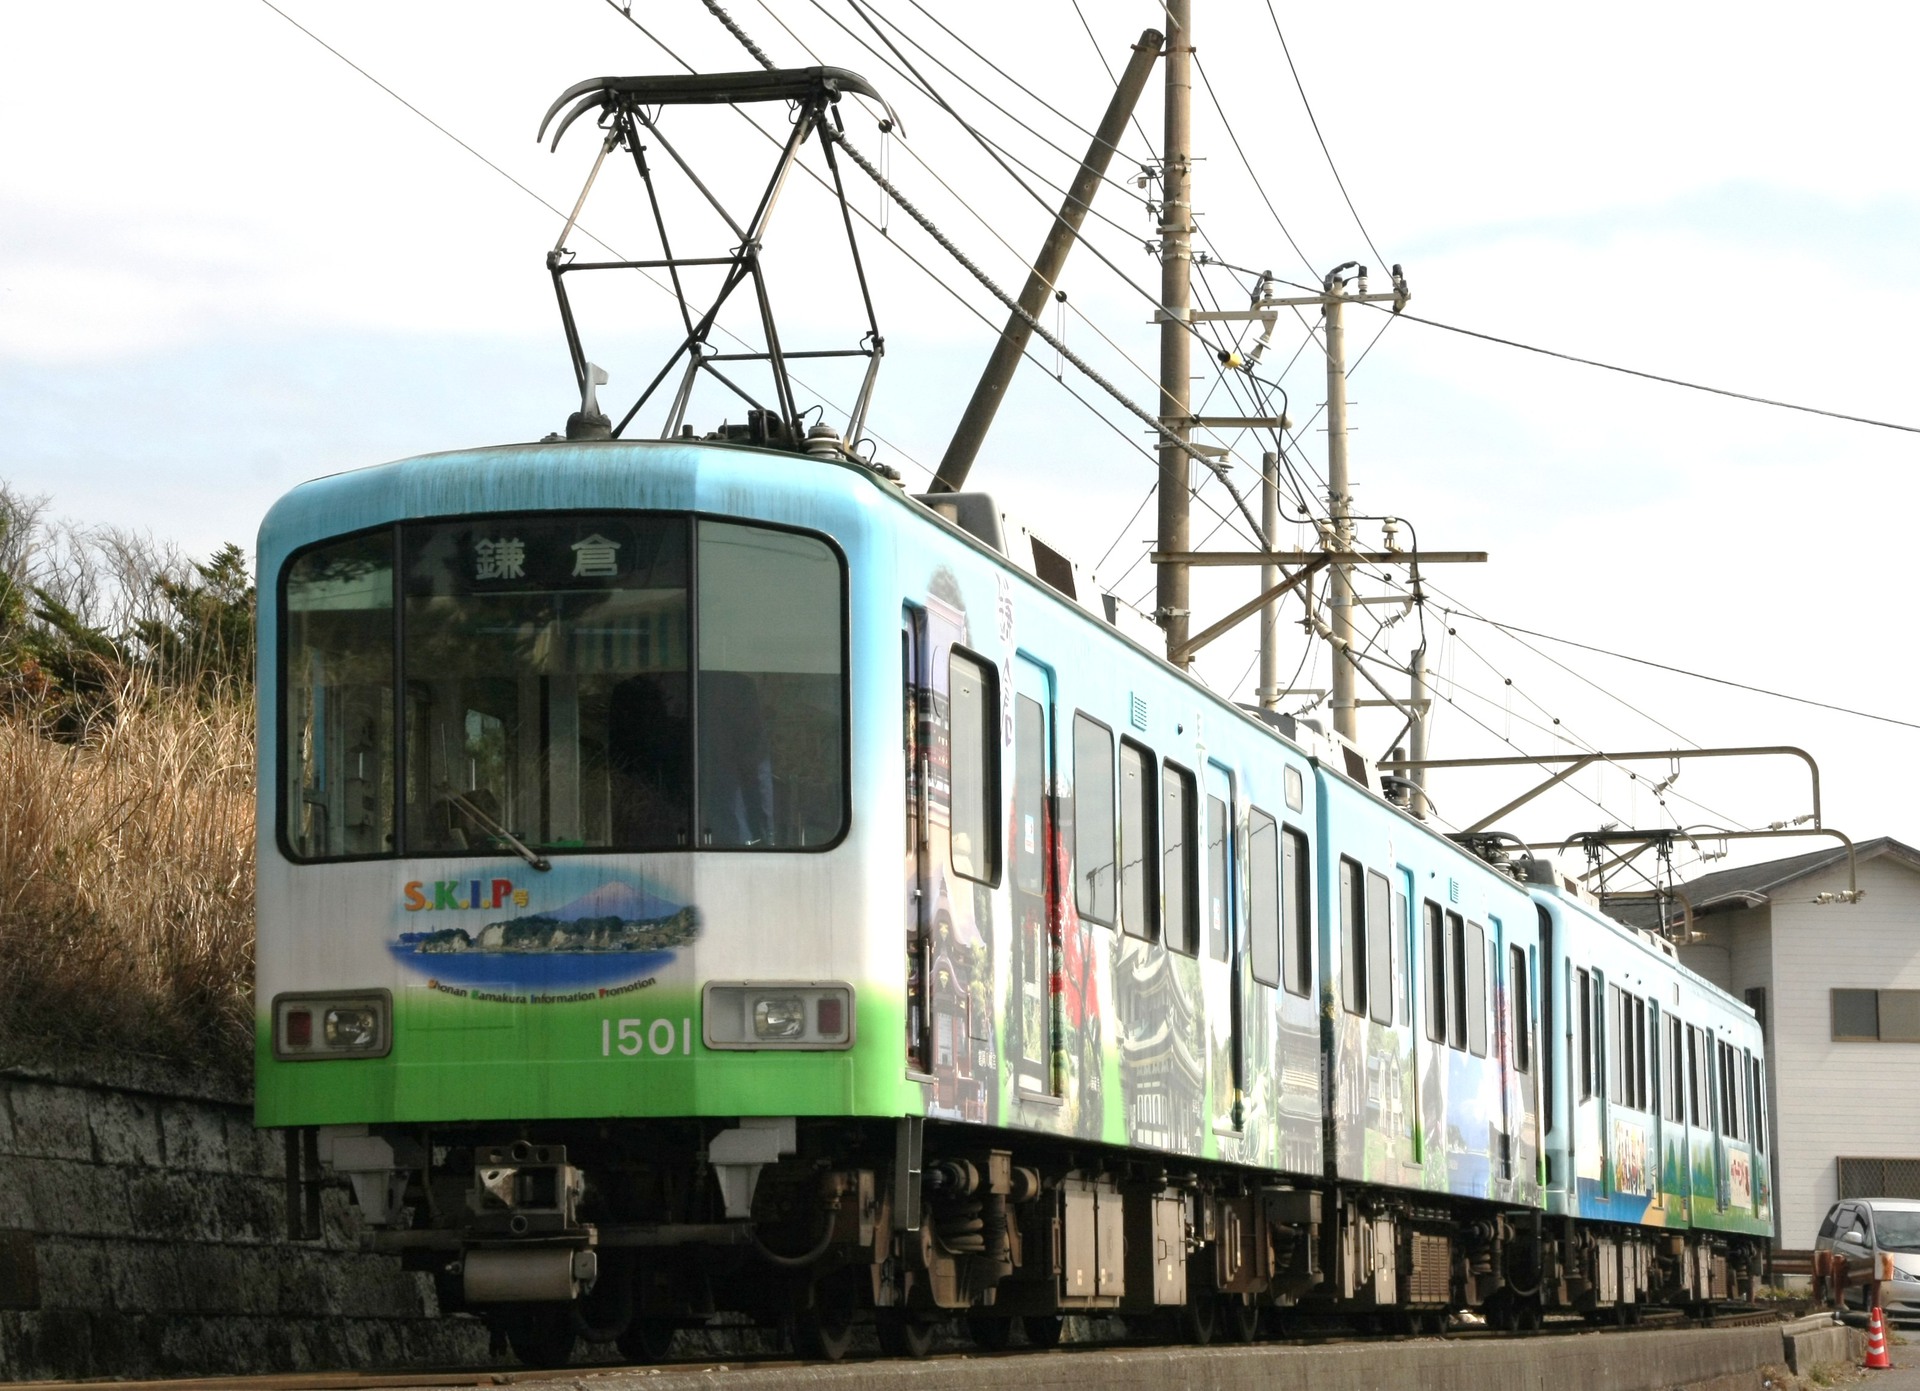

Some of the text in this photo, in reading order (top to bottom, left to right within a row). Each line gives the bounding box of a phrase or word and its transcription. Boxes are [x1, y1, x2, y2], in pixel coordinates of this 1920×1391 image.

[474, 533, 621, 580] 鎌倉
[428, 975, 656, 1005] Shonan Kamakura Information Promotion
[602, 1018, 690, 1056] 1501
